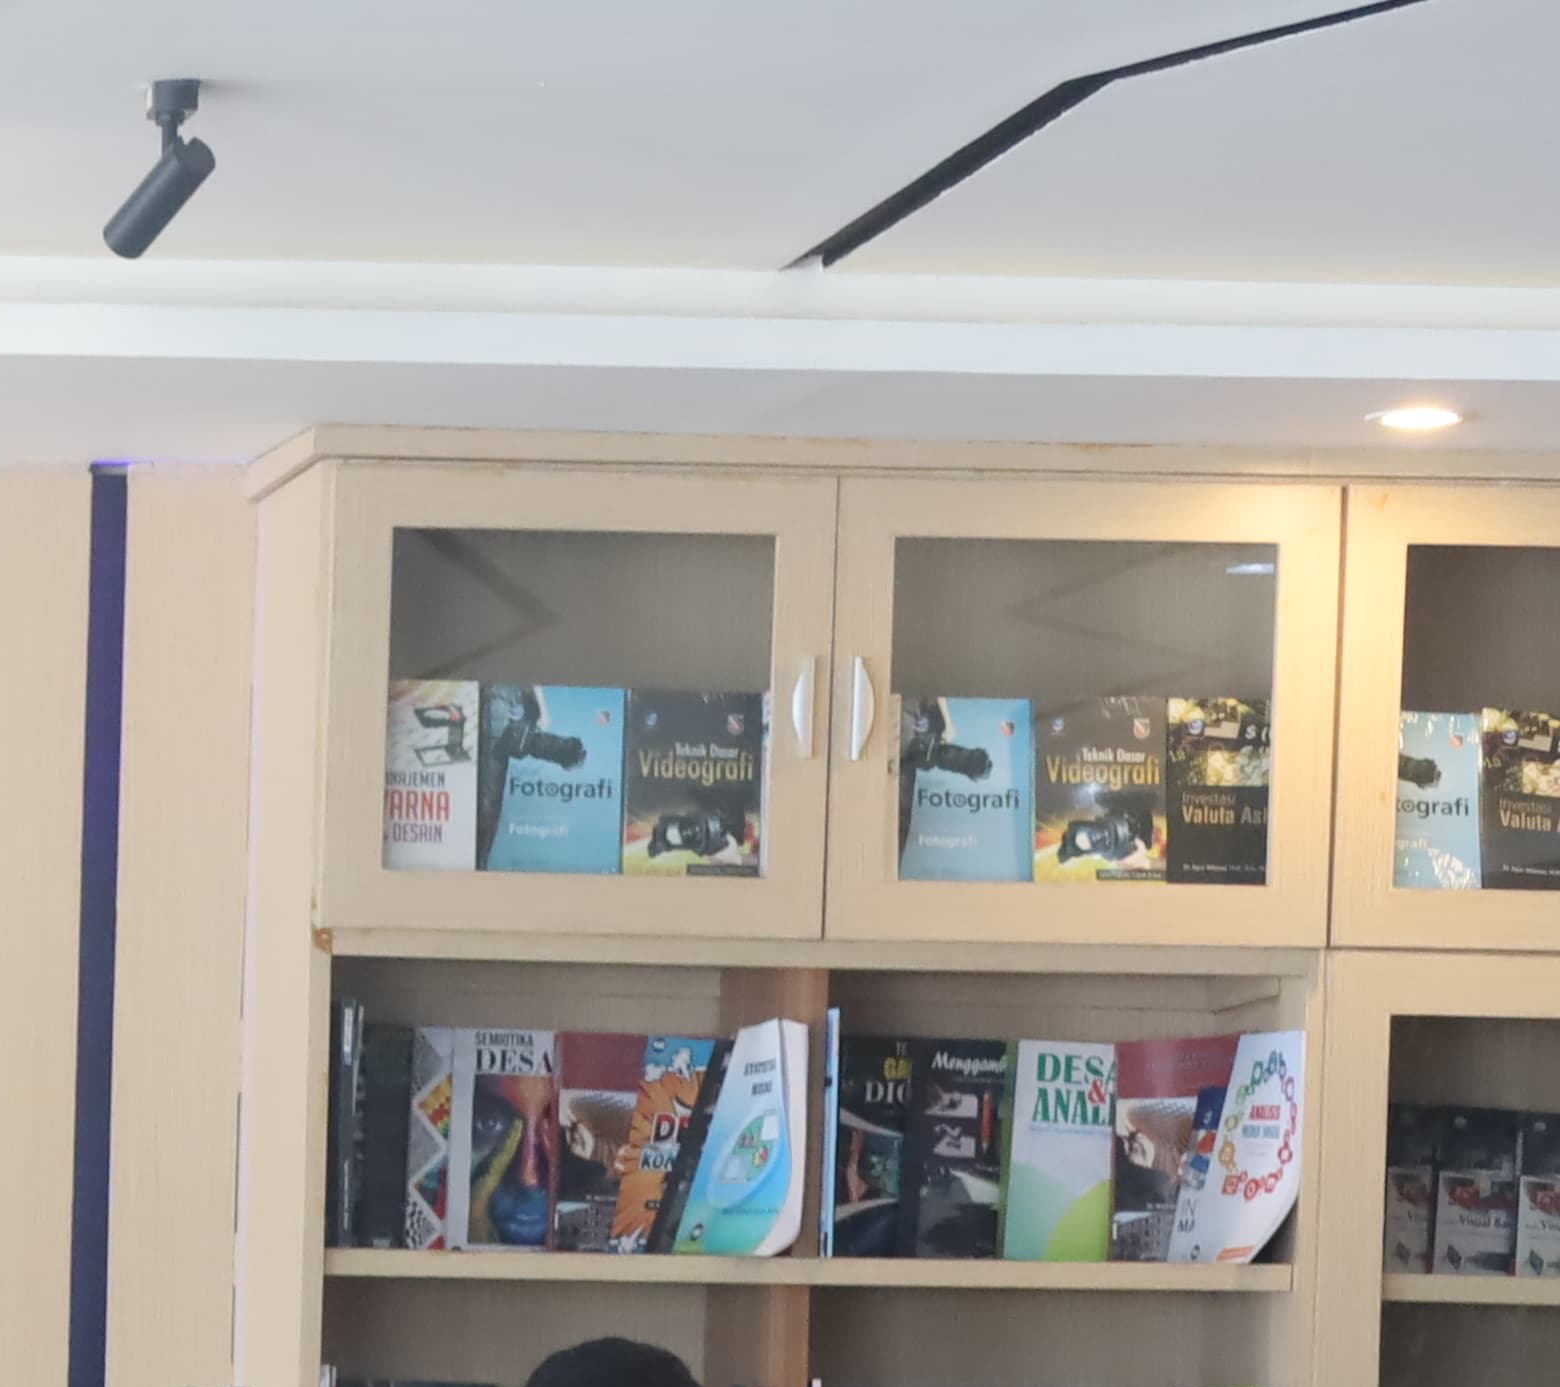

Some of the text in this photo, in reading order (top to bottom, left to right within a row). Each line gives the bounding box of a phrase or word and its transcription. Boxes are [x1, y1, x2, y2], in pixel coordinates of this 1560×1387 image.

[675, 742, 739, 759] Teknik Dasar
[1082, 747, 1147, 764] Teknik Dasar
[638, 750, 754, 786] Videografi
[1046, 756, 1161, 790] Videografi
[509, 776, 613, 803] Fotografi
[917, 788, 1021, 814] Fotografi
[1182, 805, 1236, 825] Valuta
[1499, 810, 1552, 832] Valuta
[392, 822, 443, 844] DESAIN
[475, 1031, 534, 1047] SEMIOTIKA
[1087, 1078, 1108, 1106] &
